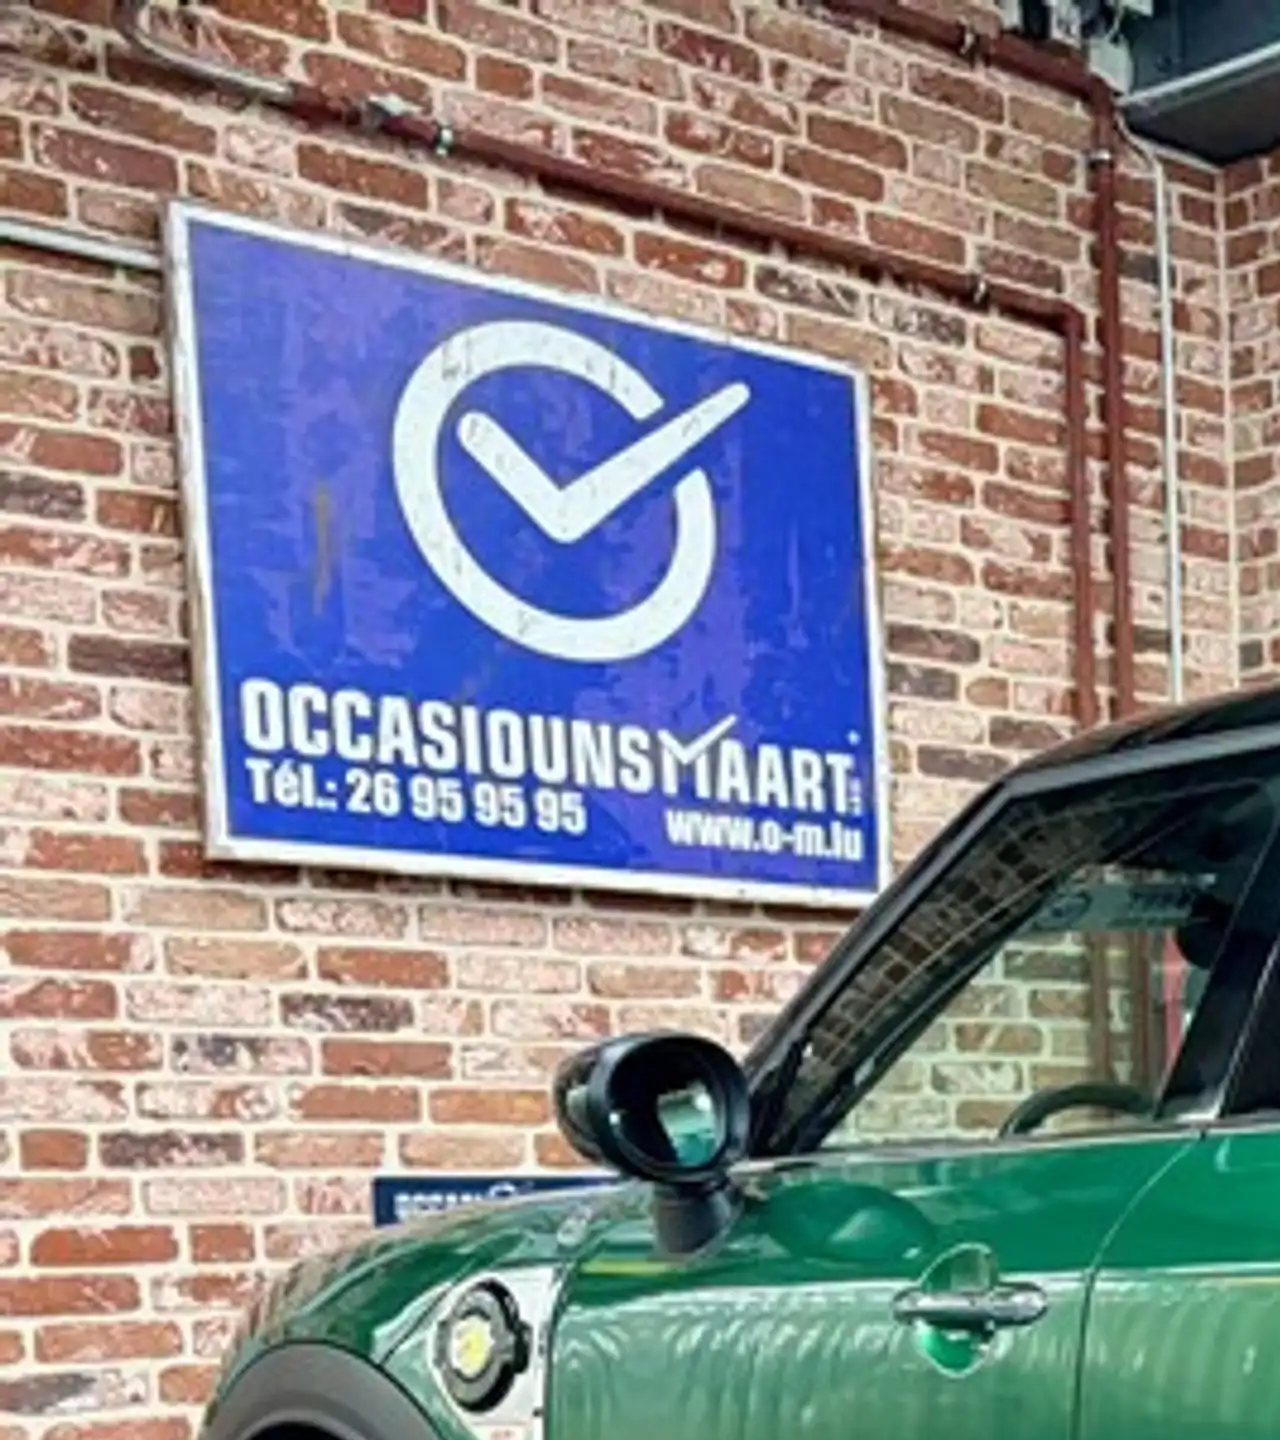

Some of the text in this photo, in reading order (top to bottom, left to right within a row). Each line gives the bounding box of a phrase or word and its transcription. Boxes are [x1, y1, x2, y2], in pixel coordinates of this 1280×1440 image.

[241, 678, 854, 817] OCCASIOUNSMAART
[246, 757, 587, 835] Tél.: 26 95 95 95
[666, 807, 864, 861] www.o-m.lu
